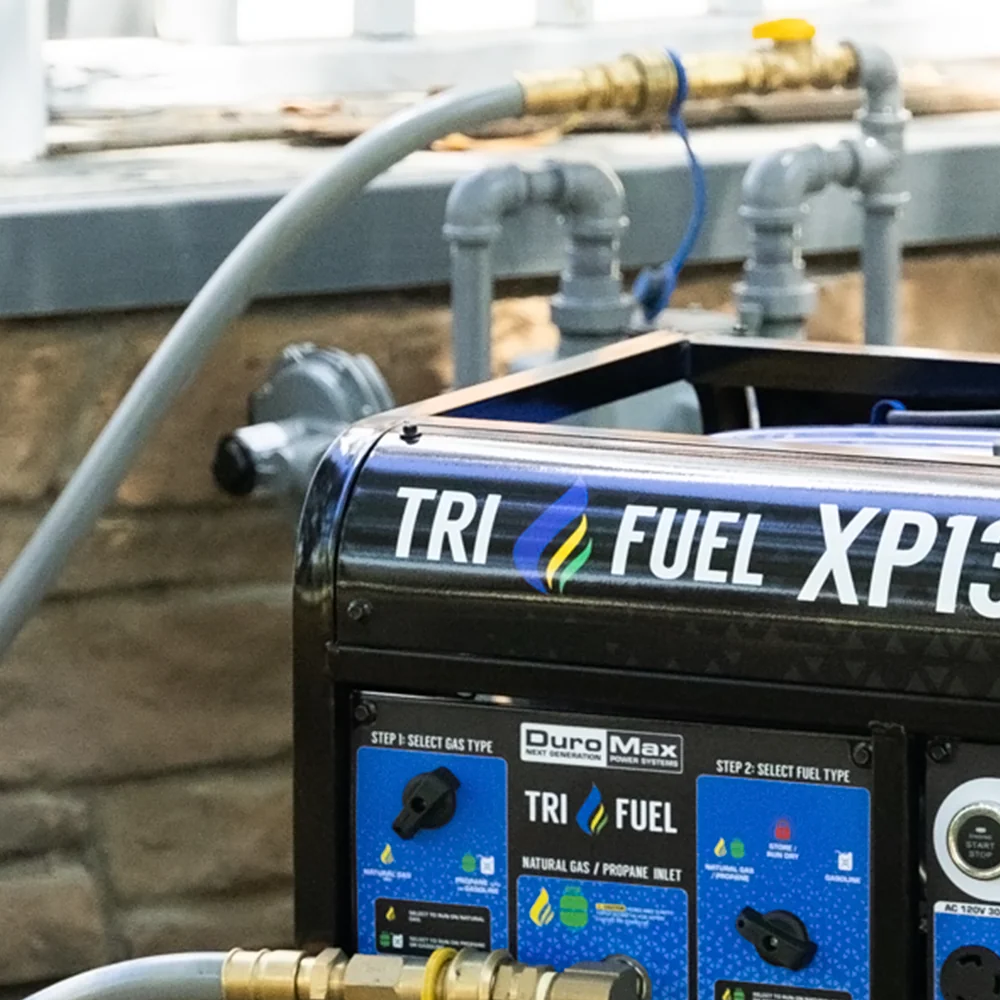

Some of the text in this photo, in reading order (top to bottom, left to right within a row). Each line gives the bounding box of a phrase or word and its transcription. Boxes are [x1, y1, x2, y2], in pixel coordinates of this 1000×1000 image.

[395, 487, 502, 564] TRI
[610, 504, 764, 587] FUEL
[371, 731, 397, 745] STEP
[407, 733, 444, 749] SELECT
[445, 737, 466, 751] GAS
[467, 739, 493, 753] TYPE
[525, 748, 602, 761] NEXT GENERATION
[609, 755, 679, 768] POWER SYSTEMS
[716, 759, 850, 783] STEP 2: SELECT FUEL TYPE
[524, 790, 678, 834] TRI FUEL
[965, 841, 995, 849] START
[968, 850, 993, 858] STOP
[522, 856, 682, 882] NATURAL GAS / PROPANE INLET
[944, 904, 958, 912] AC
[960, 905, 986, 915] 120V
